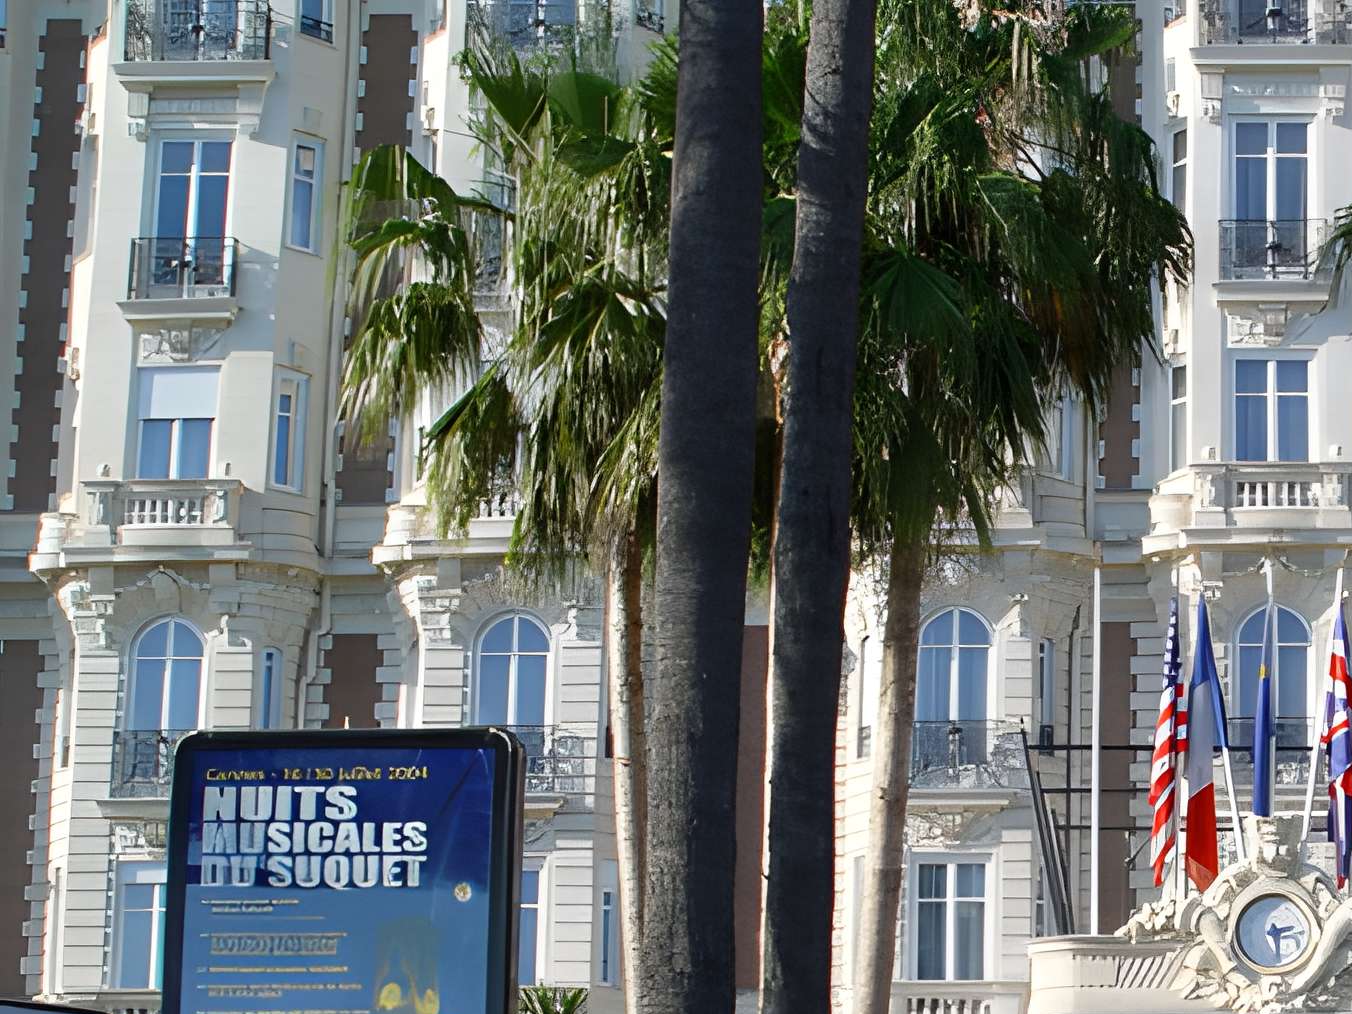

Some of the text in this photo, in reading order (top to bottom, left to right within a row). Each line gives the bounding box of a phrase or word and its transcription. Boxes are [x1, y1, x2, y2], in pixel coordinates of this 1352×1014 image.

[203, 785, 358, 821] NUITS
[202, 821, 428, 854] MUSICALES
[266, 854, 428, 890] SUQUET
